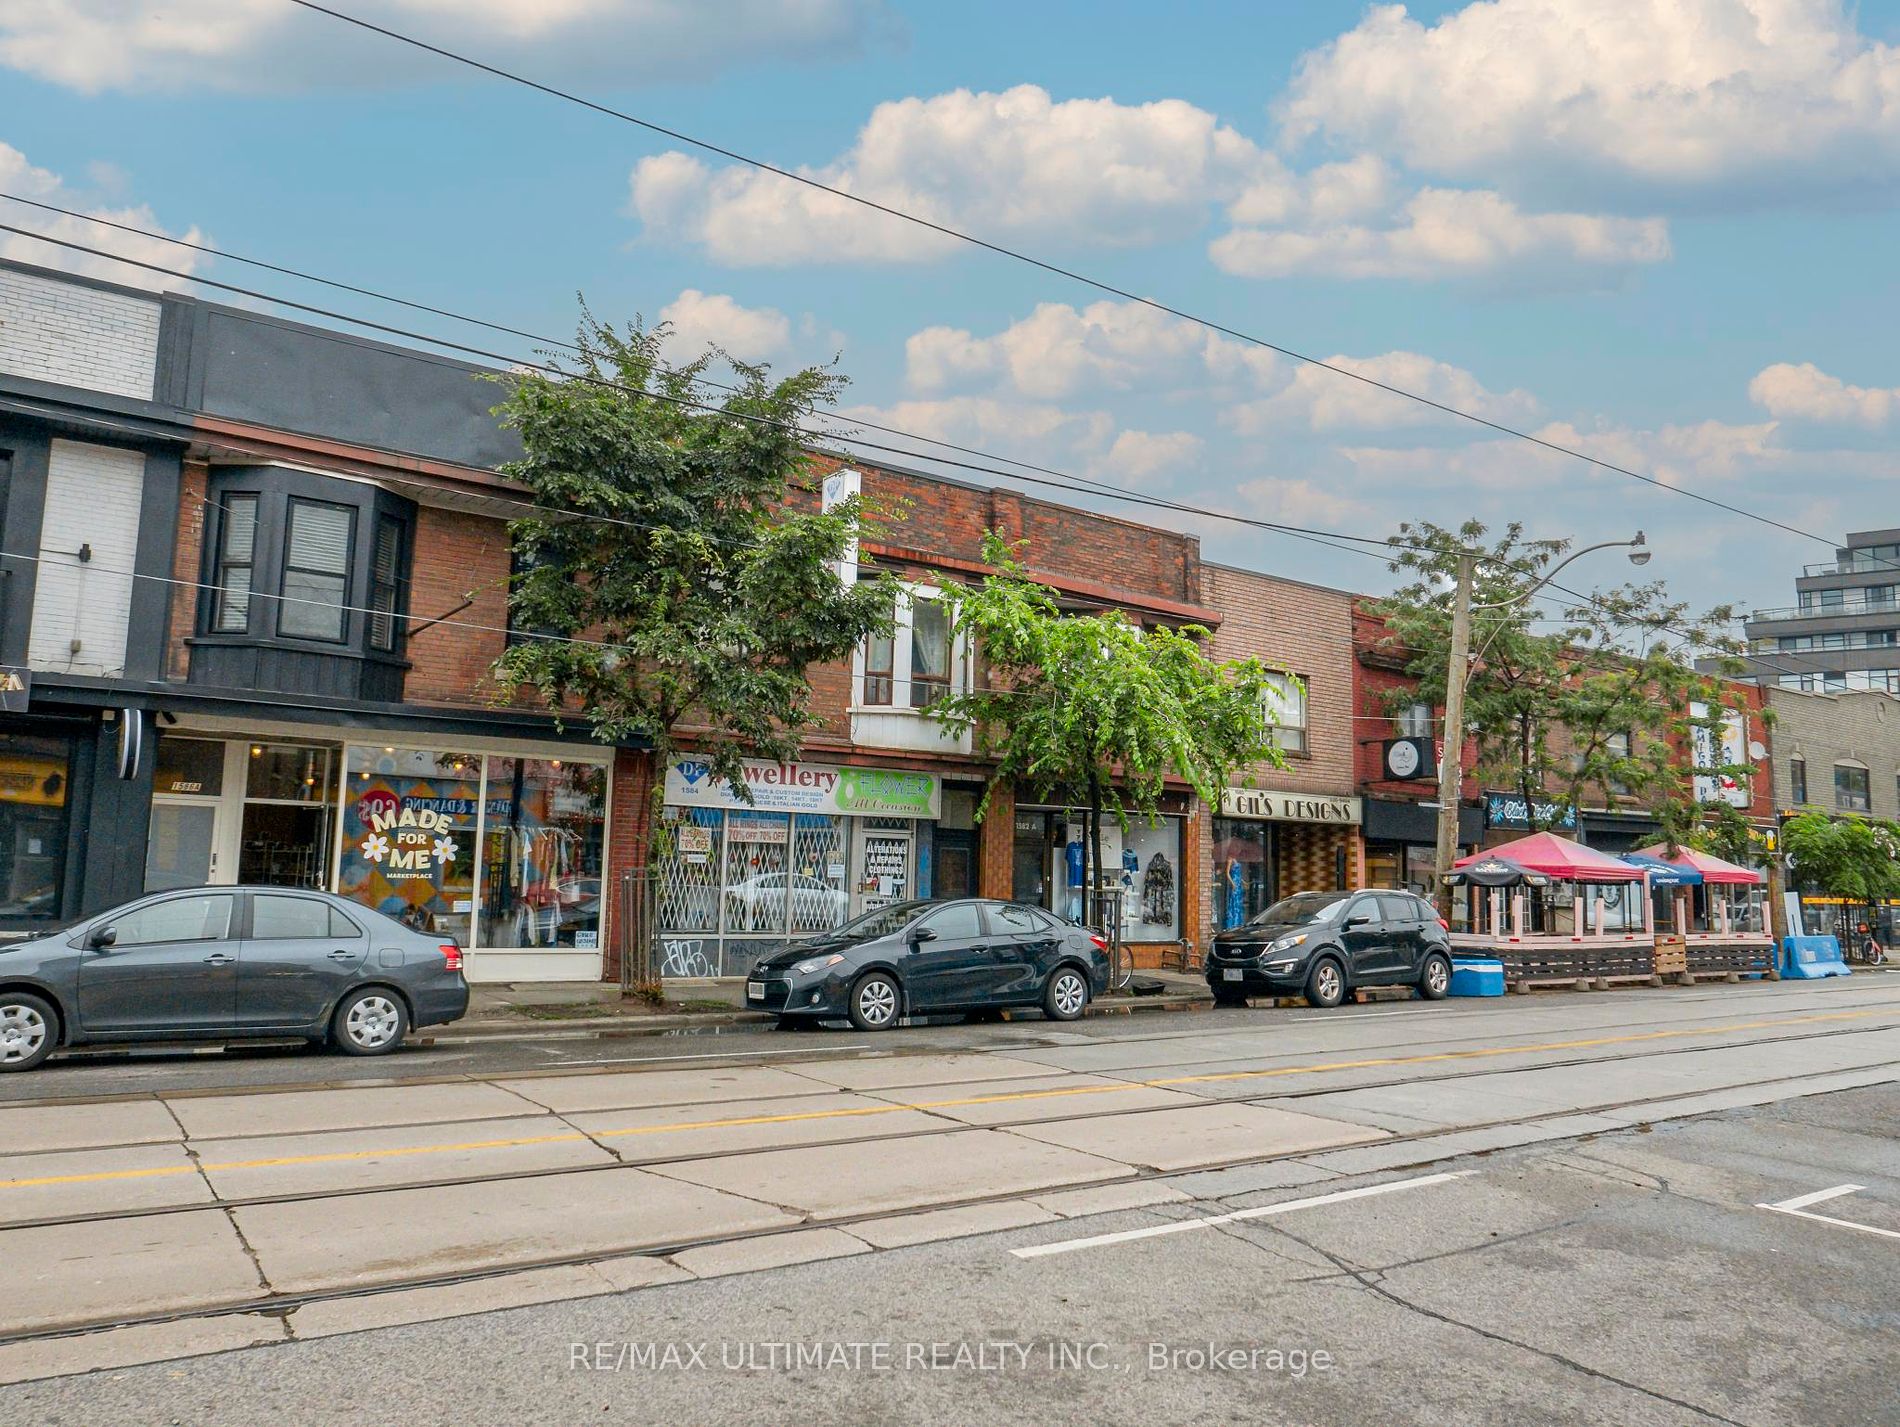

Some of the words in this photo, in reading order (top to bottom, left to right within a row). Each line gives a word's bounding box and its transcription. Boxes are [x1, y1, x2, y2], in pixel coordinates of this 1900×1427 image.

[710, 764, 838, 793] wellery
[860, 772, 929, 798] FLOWER
[1237, 792, 1273, 816] GIL'S
[1284, 799, 1351, 820] DESIGNS
[371, 807, 453, 835] MADE
[397, 833, 427, 845] FOR
[773, 832, 786, 841] OFF
[389, 848, 431, 869] ME
